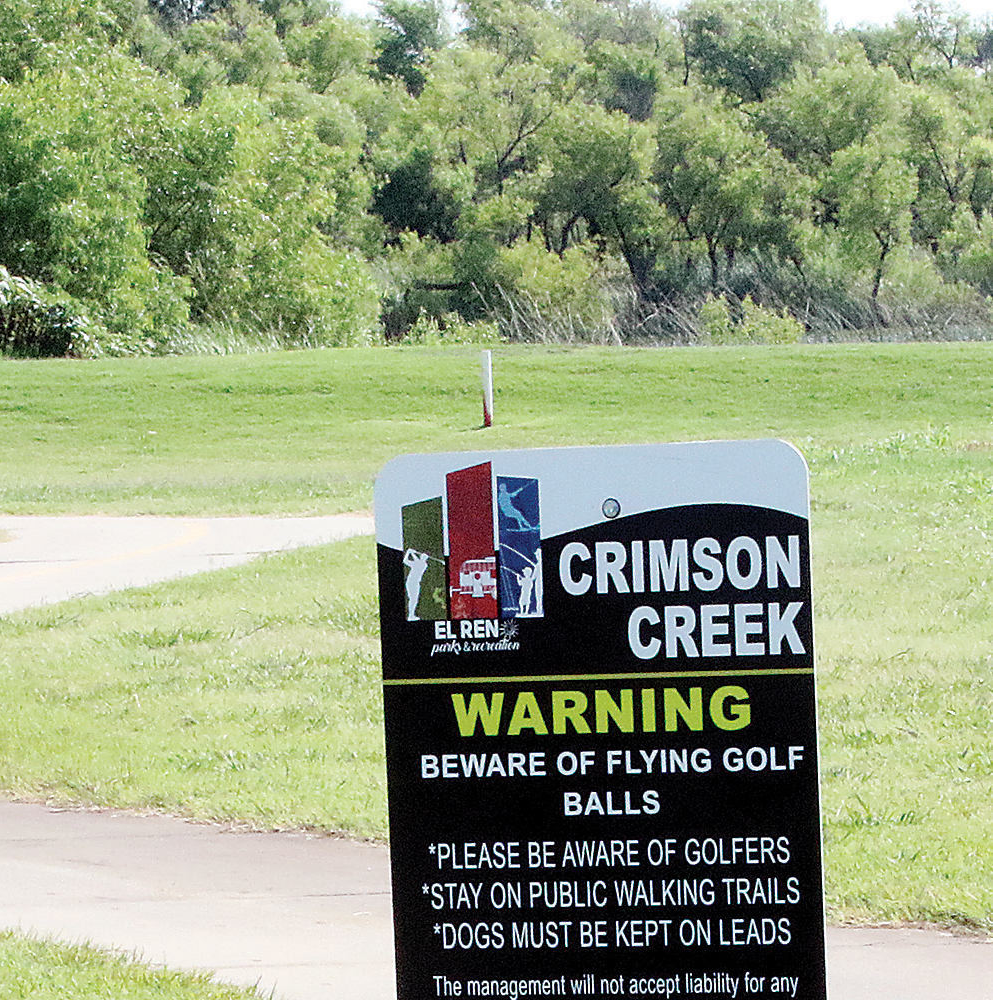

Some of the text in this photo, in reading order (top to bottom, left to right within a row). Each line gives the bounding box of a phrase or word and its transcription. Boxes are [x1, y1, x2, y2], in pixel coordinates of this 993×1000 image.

[559, 535, 801, 595] CRIMSON
[434, 621, 457, 639] EL
[628, 602, 806, 660] CREEK
[451, 686, 751, 736] WARNING
[421, 746, 804, 778] BEWARE OF FLYING GOLF
[564, 790, 660, 816] BALLS
[528, 841, 556, 868] BE
[562, 840, 640, 867] AWARE
[648, 839, 677, 866] OF
[685, 837, 790, 865] GOLFERS
[491, 882, 521, 909] ON
[529, 880, 607, 908] PUBLIC
[614, 878, 715, 906] WALKING
[722, 877, 800, 905] TRAILS
[512, 921, 572, 948] MUST
[580, 921, 608, 947] BE
[616, 920, 672, 947] KEPT
[679, 919, 711, 946] ON
[719, 918, 791, 945] LEADS
[433, 972, 798, 1000] The management will not accept liability for any
